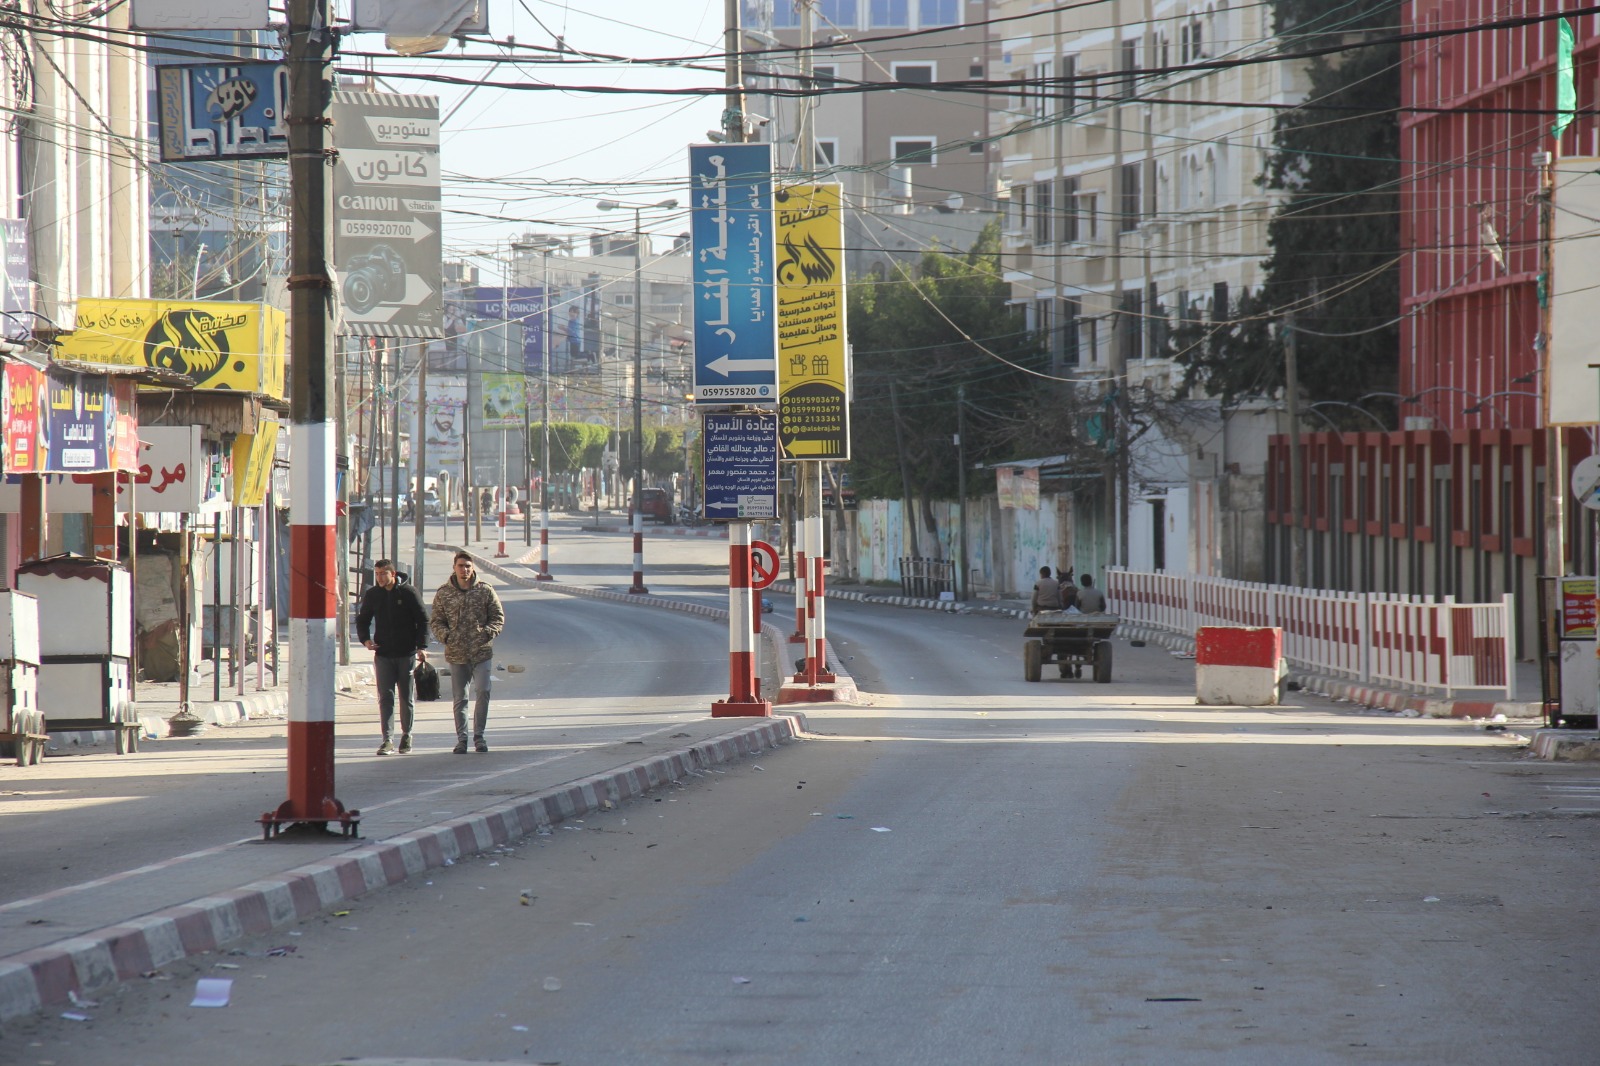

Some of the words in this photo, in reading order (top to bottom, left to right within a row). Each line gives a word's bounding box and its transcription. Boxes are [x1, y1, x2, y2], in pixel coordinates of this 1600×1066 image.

[182, 65, 290, 156] لخطاط
[377, 122, 430, 140] ستوديو
[357, 153, 428, 181] كانون
[408, 200, 435, 211] studio
[699, 154, 736, 263] مكتبة
[779, 204, 829, 228] مكتبة
[346, 222, 412, 236] 0599920700
[485, 303, 501, 313] LC
[703, 268, 736, 345] المنار
[813, 297, 836, 311] أدوات
[99, 308, 118, 330] كل
[779, 306, 811, 319] مدرسية
[814, 311, 836, 323] تصوير
[77, 316, 96, 328] طال
[200, 313, 247, 336] مكتبة
[778, 317, 812, 328] مستندات
[779, 327, 810, 340] تعليمية
[811, 323, 837, 335] وسائل
[702, 387, 756, 397] 0597557820
[791, 396, 840, 404] 0595903679
[791, 405, 841, 413] 0599903679
[708, 417, 743, 434] الأسرة
[746, 418, 775, 433] عيادة
[726, 469, 747, 477] منصور
